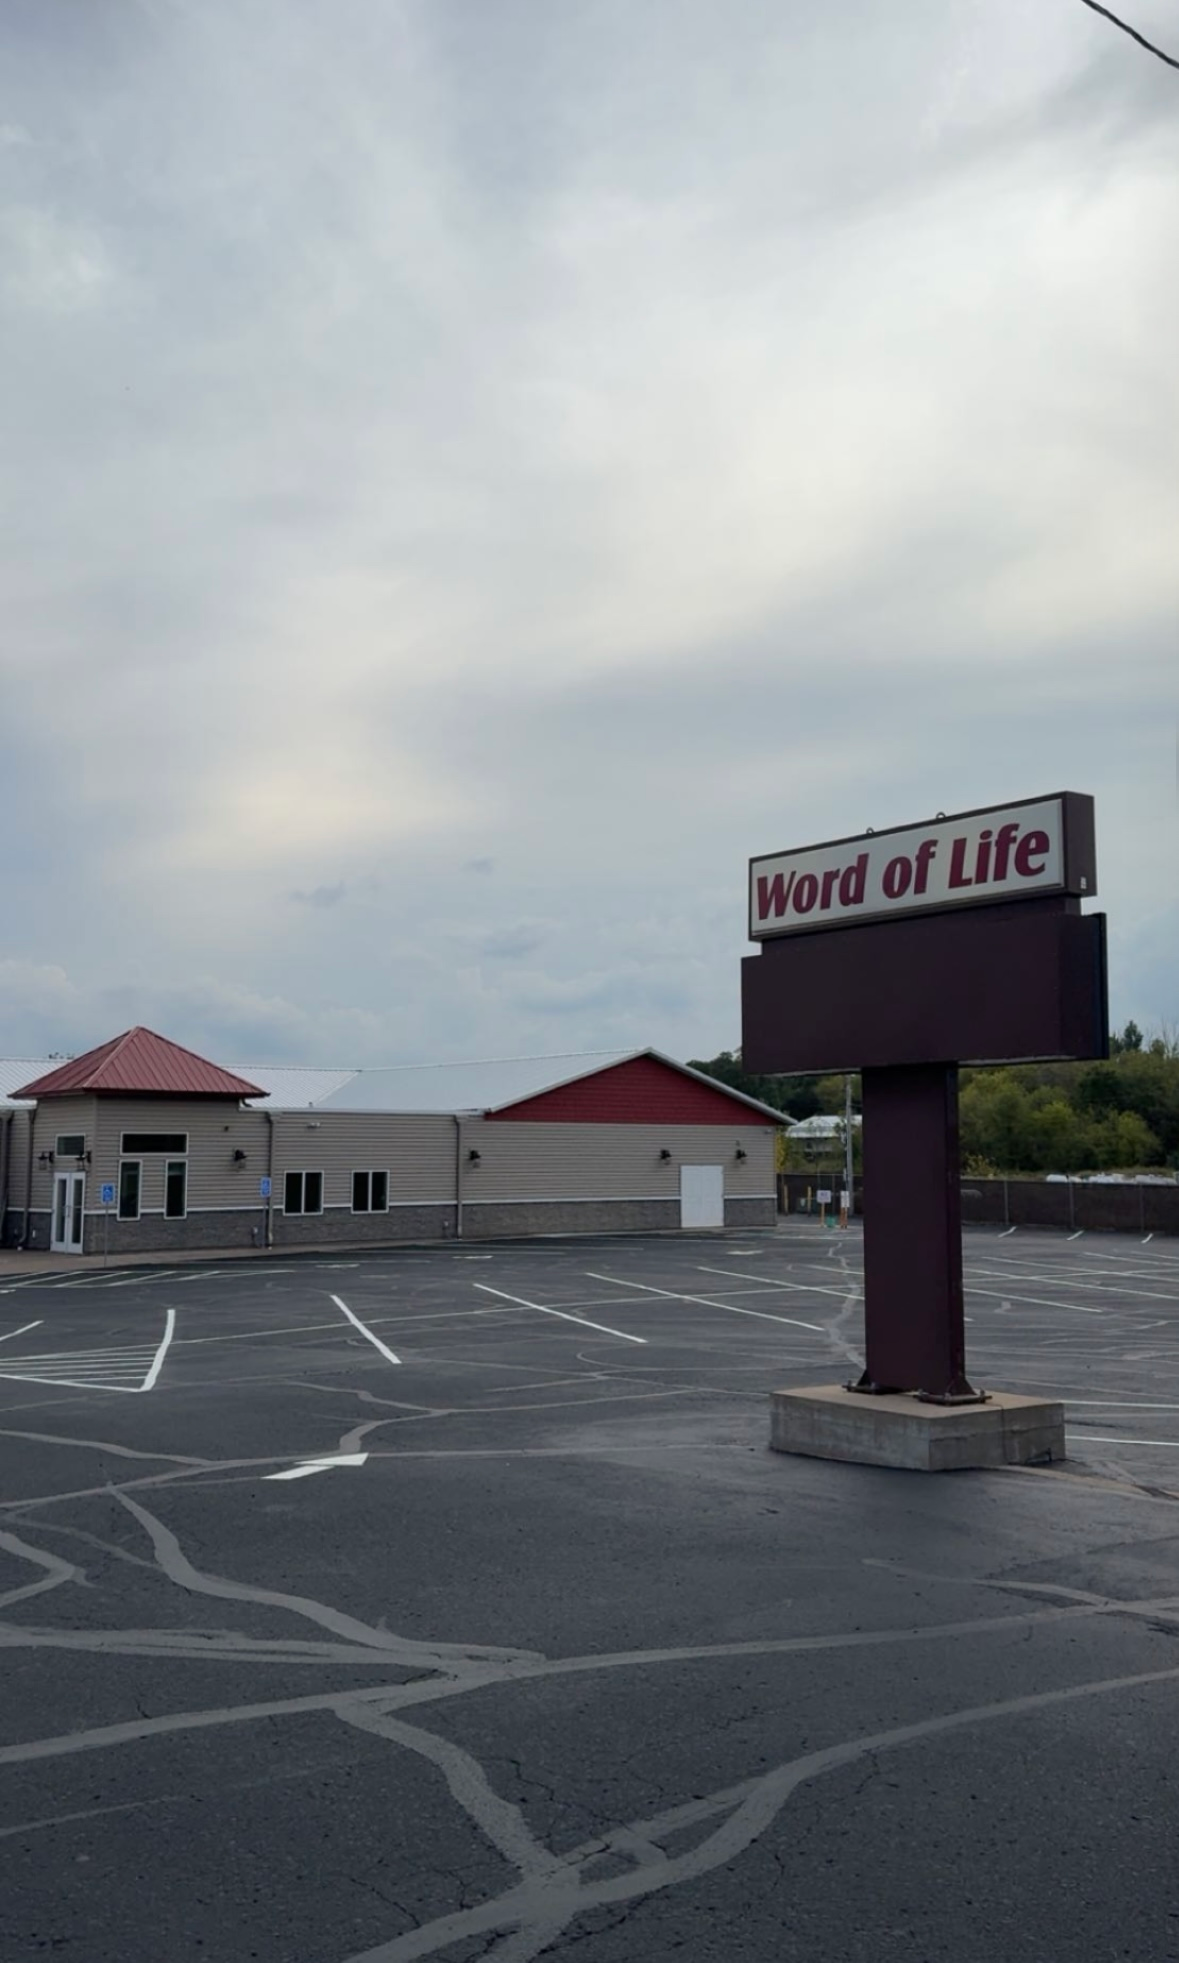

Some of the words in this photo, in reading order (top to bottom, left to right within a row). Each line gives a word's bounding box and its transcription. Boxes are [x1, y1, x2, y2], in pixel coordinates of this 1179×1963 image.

[757, 853, 869, 920] Word
[882, 839, 938, 899] of
[948, 823, 1050, 889] Life
